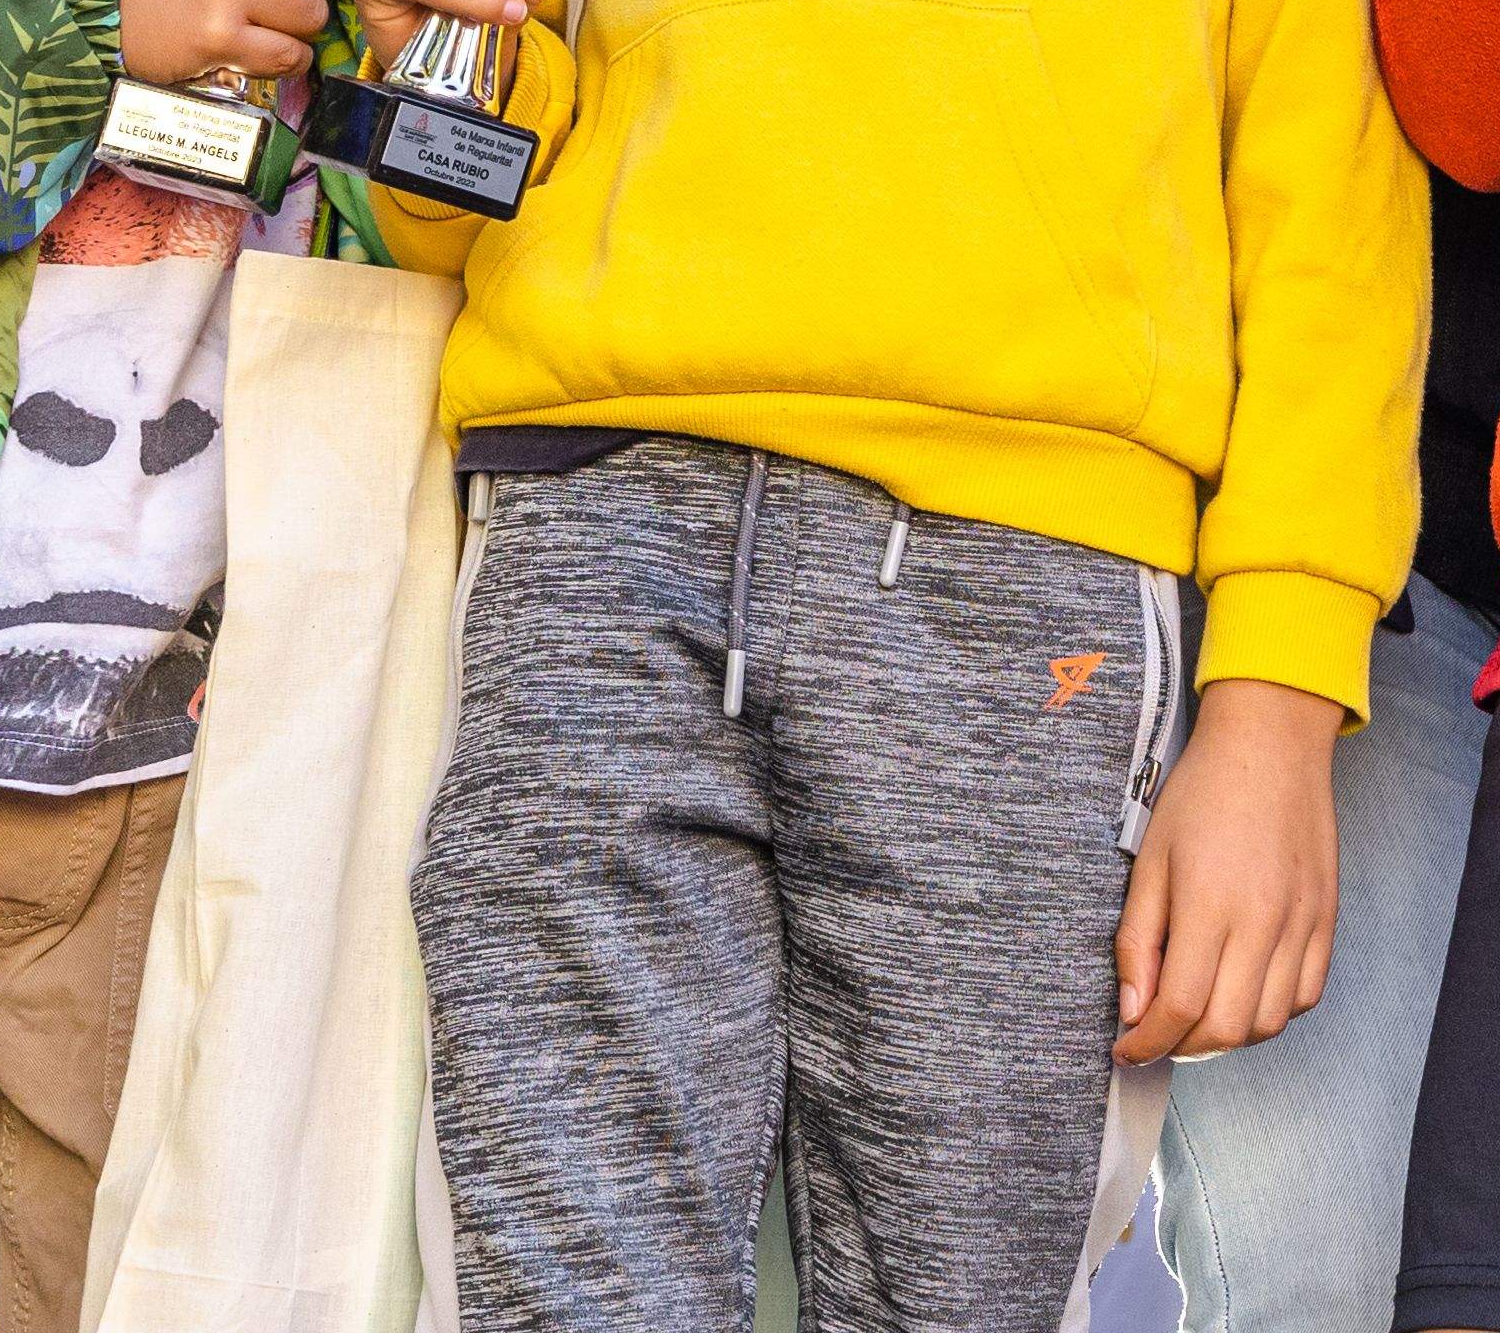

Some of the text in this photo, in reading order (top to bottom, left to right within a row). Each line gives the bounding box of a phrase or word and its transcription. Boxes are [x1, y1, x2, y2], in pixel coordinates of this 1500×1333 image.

[118, 122, 173, 145] LLEGUMS
[191, 142, 239, 162] ANGELS
[450, 125, 467, 139] 64a
[468, 130, 495, 148] Marxa
[497, 138, 526, 157] Infantil
[454, 141, 513, 168] de Regularitat
[417, 149, 490, 181] CASA RUBIO
[424, 166, 476, 189] Octubre 2023
